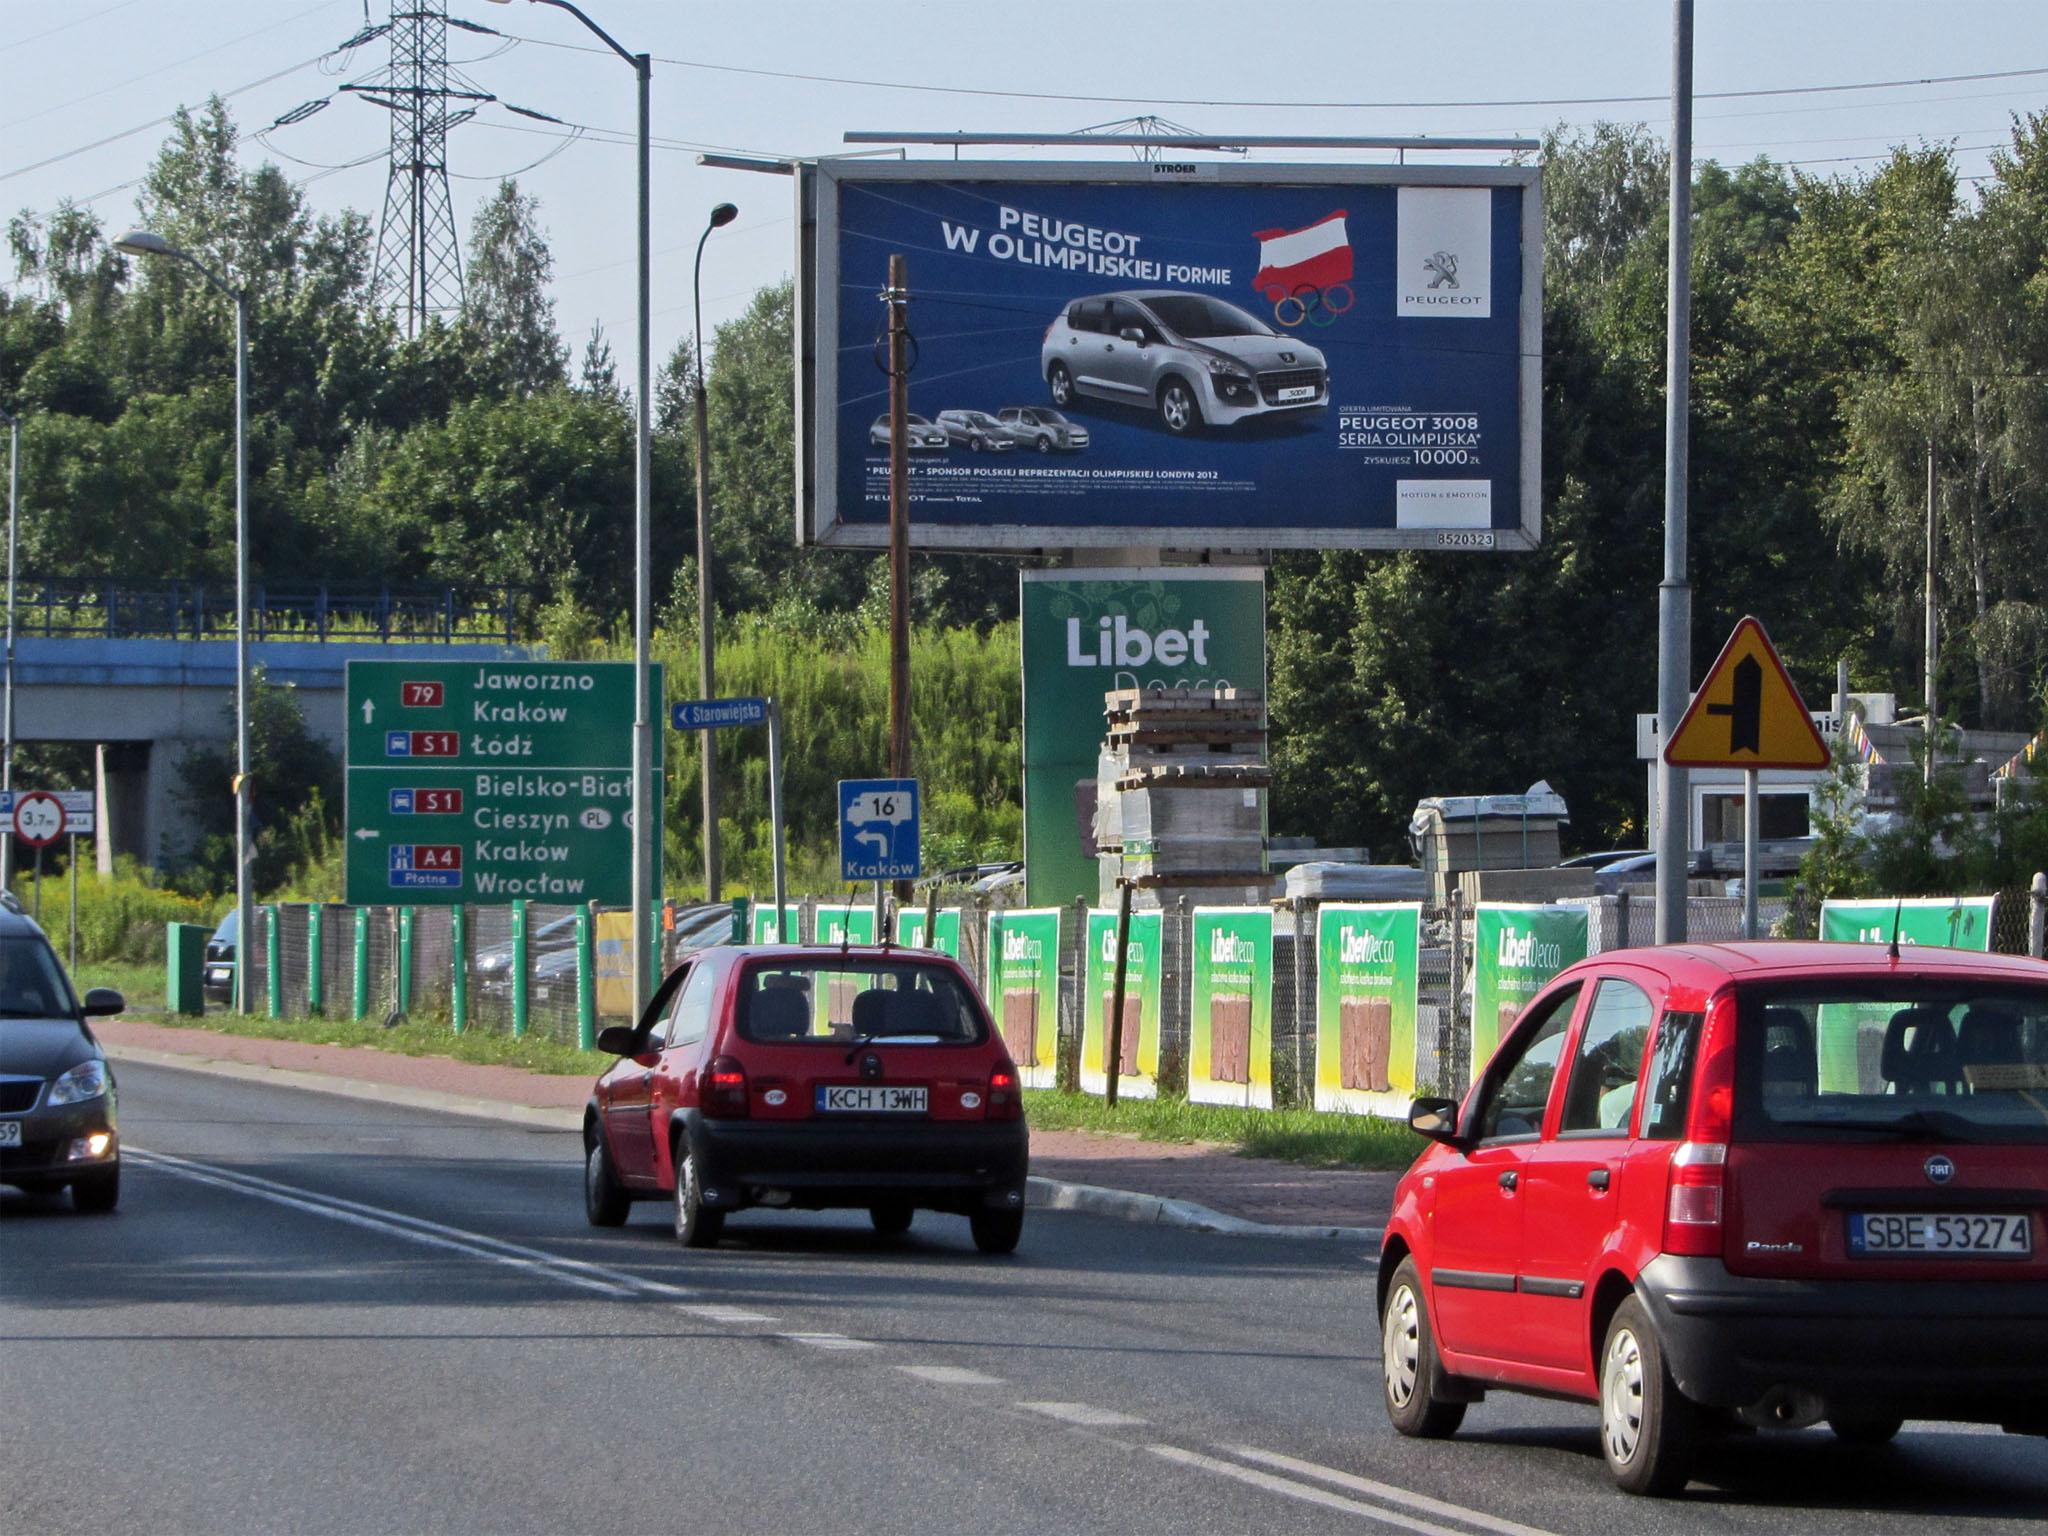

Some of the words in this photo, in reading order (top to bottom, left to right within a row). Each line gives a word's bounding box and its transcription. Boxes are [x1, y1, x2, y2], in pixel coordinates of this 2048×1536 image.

[1000, 206, 1141, 256] PEUGEOT
[941, 221, 980, 253] W
[988, 234, 1161, 281] OLIMPIJSKIEJ
[1166, 265, 1231, 285] FORMIE
[1405, 296, 1482, 304] PEUGEOT
[1340, 417, 1427, 430] PEUGEOT
[1432, 417, 1478, 430] 3008
[1339, 432, 1382, 446] SERIA
[926, 467, 972, 476] SPONSOR
[974, 467, 1016, 477] POLSKIEJ
[1019, 468, 1090, 478] REPREZENTACJI
[1092, 470, 1154, 478] OLIMPIJSKIEJ
[1156, 471, 1195, 479] LONDYN
[1197, 471, 1218, 479] 2012
[1438, 533, 1493, 545] 8520323
[1067, 615, 1209, 666] Libet
[474, 668, 594, 690] Jaworzno
[412, 686, 434, 702] 79
[474, 700, 568, 722] Kraków
[693, 703, 761, 723] Starowiejska
[471, 734, 533, 755] Łódź
[474, 807, 570, 834] Cieszyn
[587, 812, 603, 825] PL
[475, 840, 569, 861] Kraków
[474, 872, 584, 894] Wrocław
[1929, 1164, 1950, 1176] FIAT
[1866, 1217, 1924, 1249] SBE
[1935, 1217, 2028, 1250] 53274
[1747, 1241, 1802, 1251] Panda
